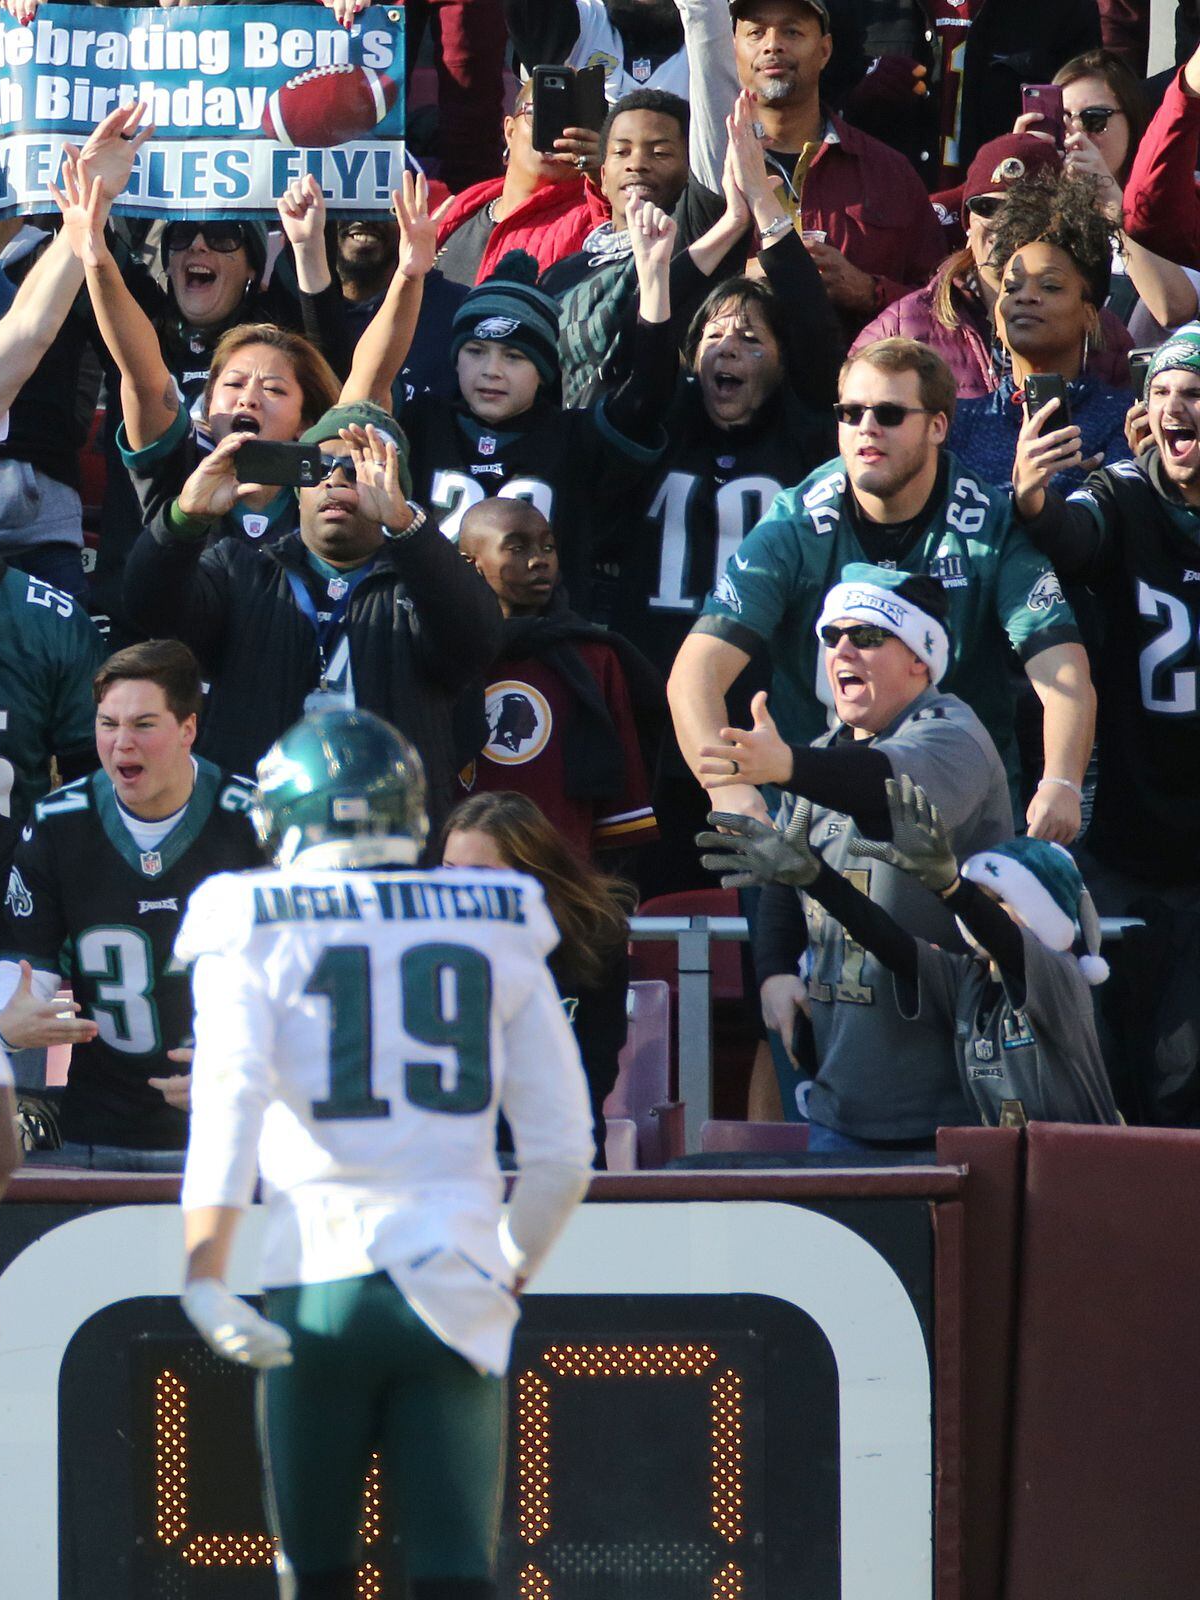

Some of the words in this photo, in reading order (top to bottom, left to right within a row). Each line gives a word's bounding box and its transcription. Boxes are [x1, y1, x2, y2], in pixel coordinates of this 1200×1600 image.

[244, 21, 393, 69] Ben's
[35, 74, 268, 131] Birthday
[272, 150, 392, 199] FLY!
[303, 942, 493, 1121] 19
